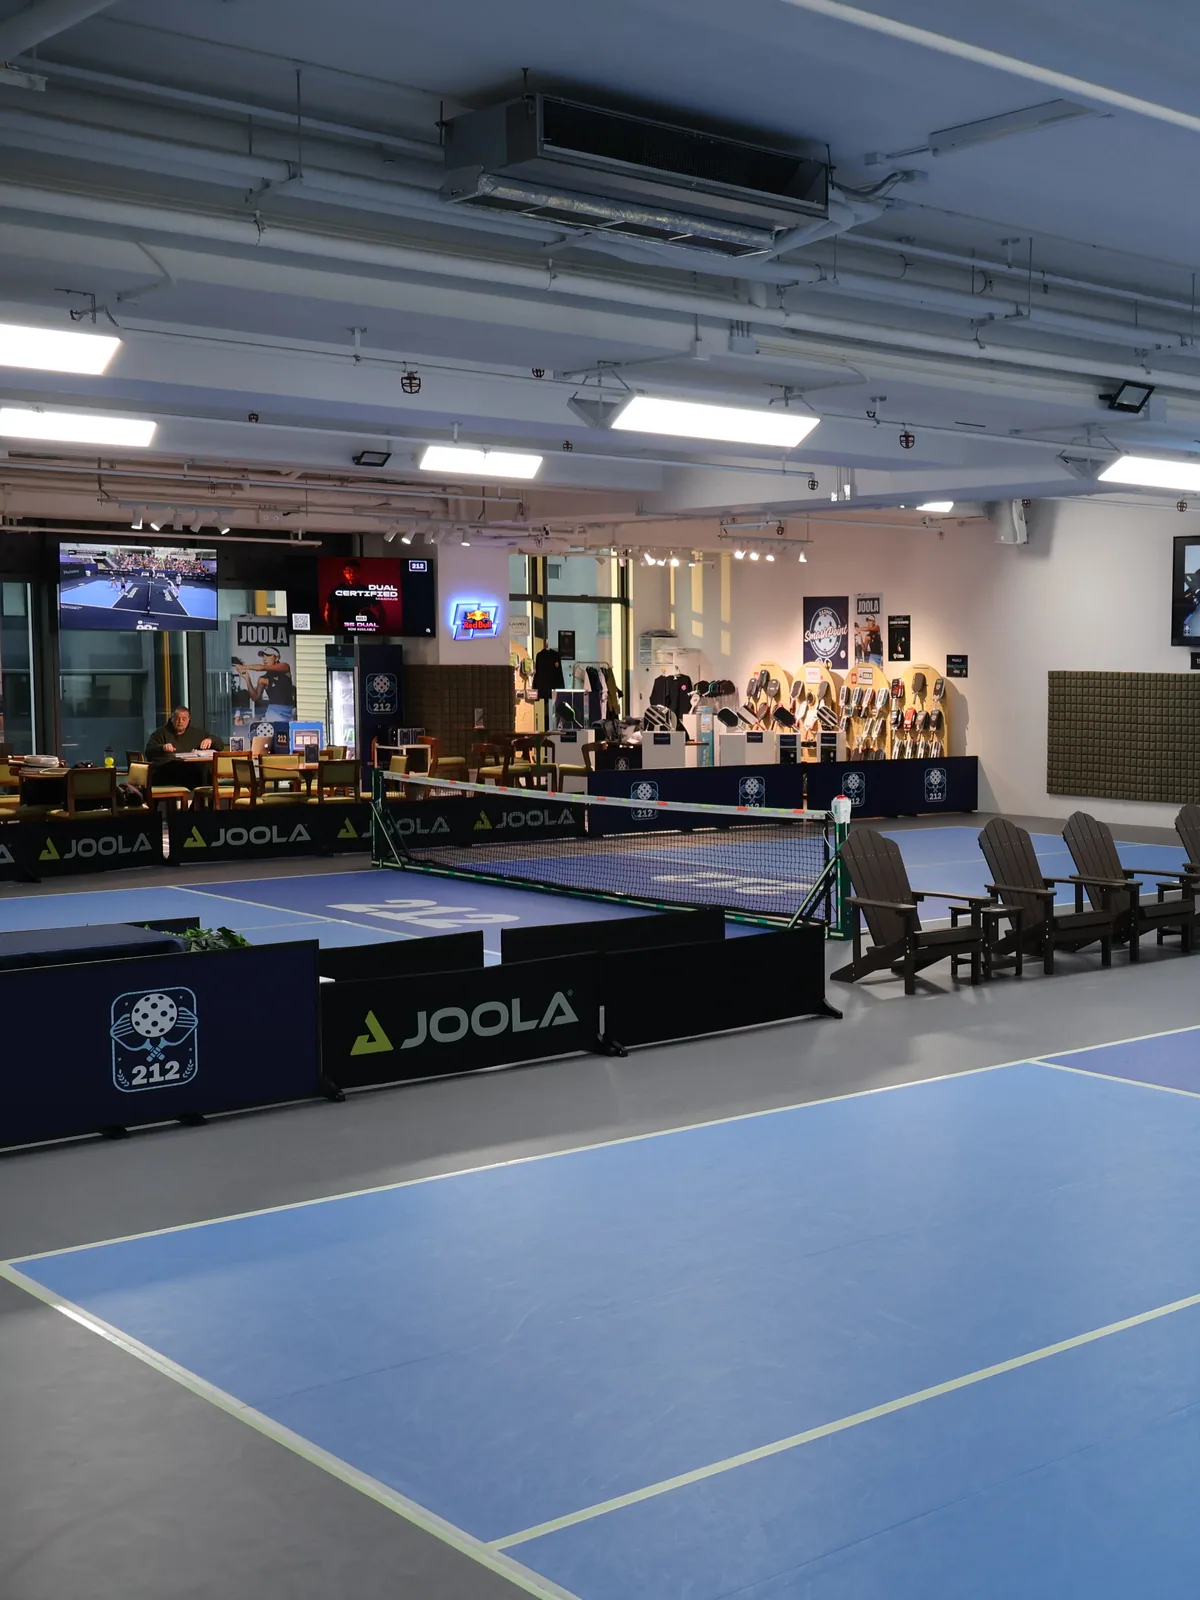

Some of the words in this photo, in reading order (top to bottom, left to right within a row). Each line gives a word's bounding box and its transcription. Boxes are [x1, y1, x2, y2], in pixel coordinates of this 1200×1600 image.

[857, 600, 880, 613] JOOLA
[240, 625, 288, 644] JOOLA
[463, 621, 478, 629] Red
[478, 620, 492, 629] Bull
[373, 703, 391, 712] 212
[929, 792, 942, 801] 212
[495, 808, 576, 830] JOOLA
[636, 809, 654, 819] 212
[210, 823, 312, 848] JOOLA
[63, 832, 153, 860] JOOLA
[325, 899, 521, 929] 212
[400, 991, 580, 1050] JOOLA
[131, 1060, 180, 1086] 212
